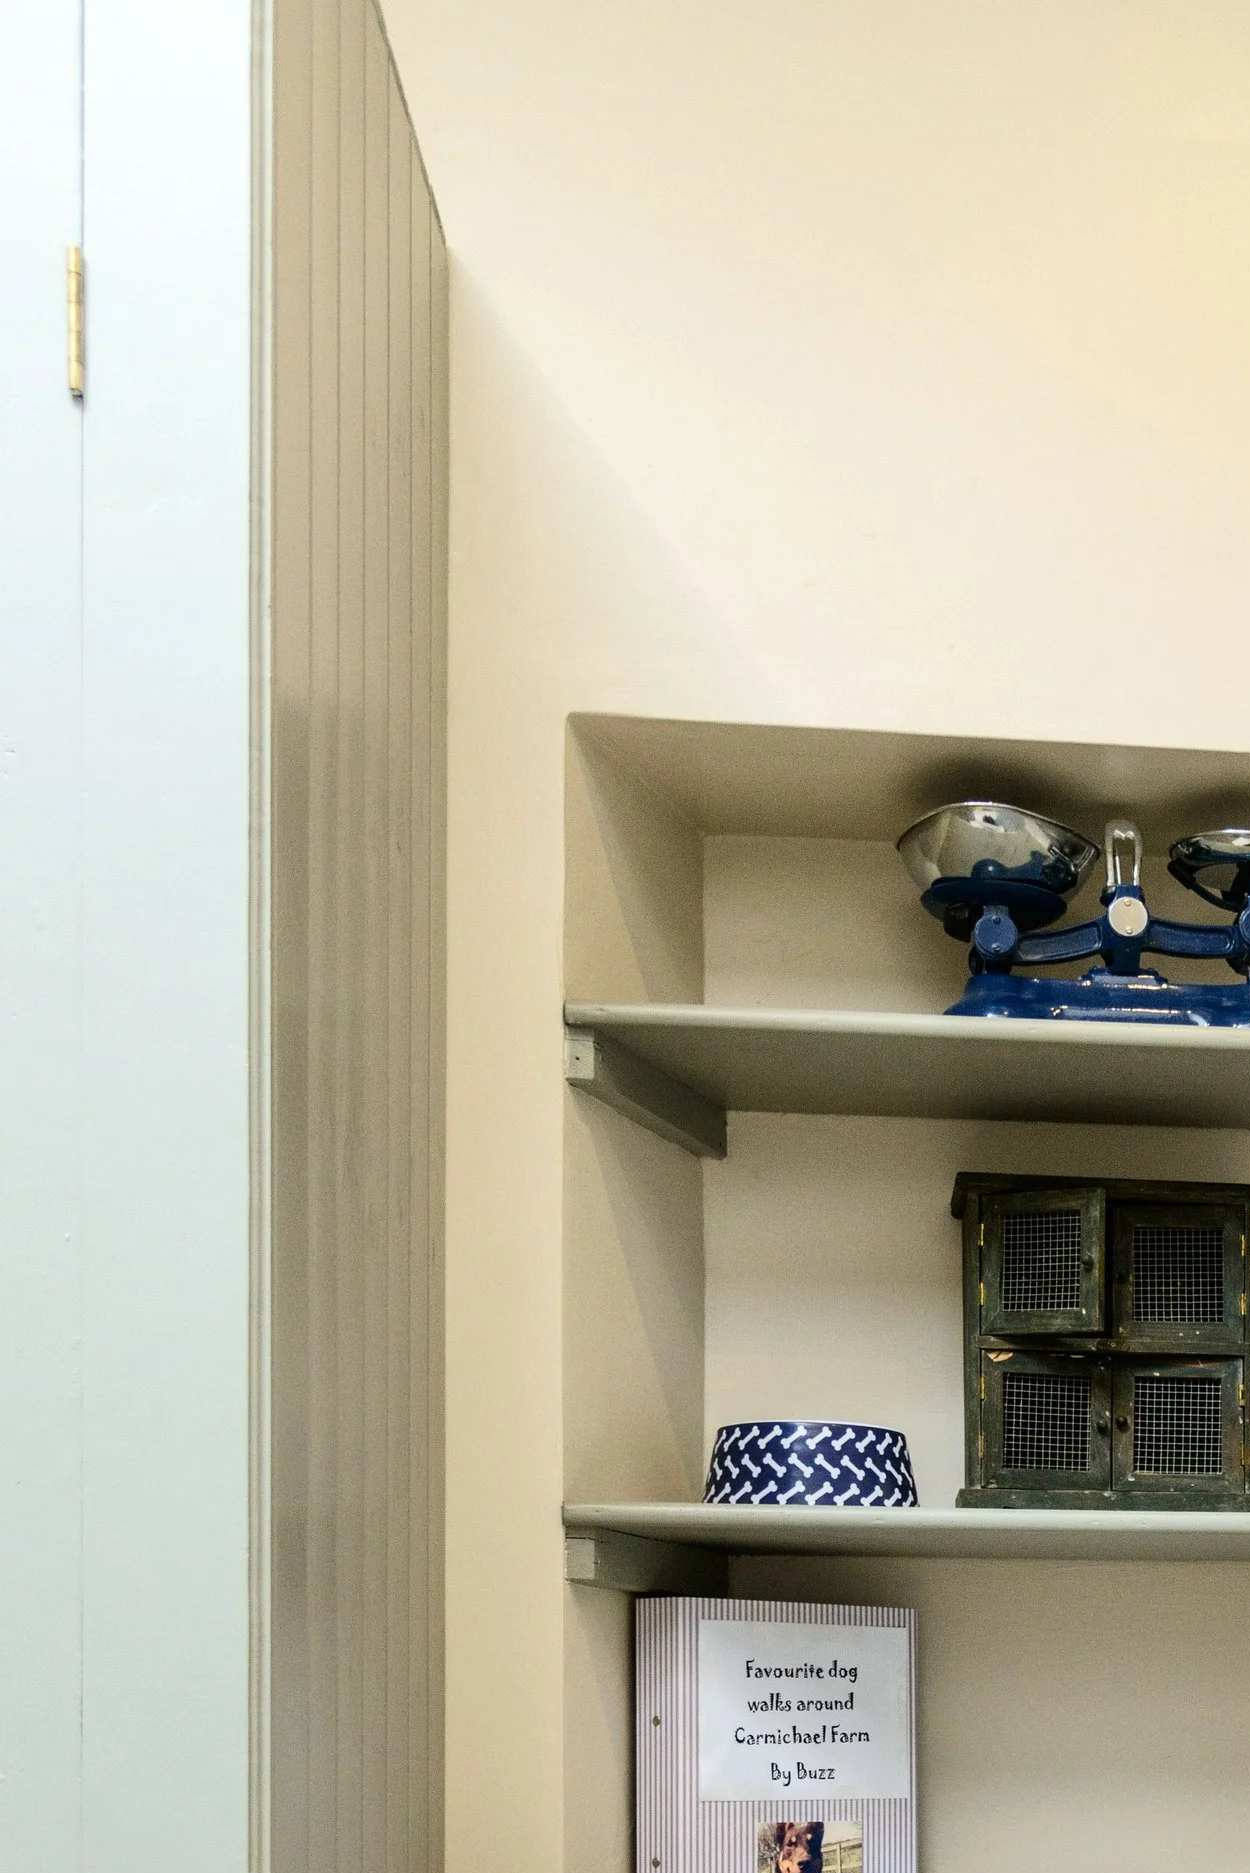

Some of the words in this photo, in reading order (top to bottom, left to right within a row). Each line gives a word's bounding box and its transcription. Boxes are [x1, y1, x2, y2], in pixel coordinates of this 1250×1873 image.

[746, 1659, 824, 1679] Favourite
[829, 1660, 858, 1683] dog
[748, 1692, 792, 1713] walks
[797, 1692, 854, 1711] around
[735, 1725, 826, 1745] Carmichael
[831, 1724, 870, 1743] Farm
[771, 1762, 791, 1786] By
[797, 1762, 835, 1780] Buzz
